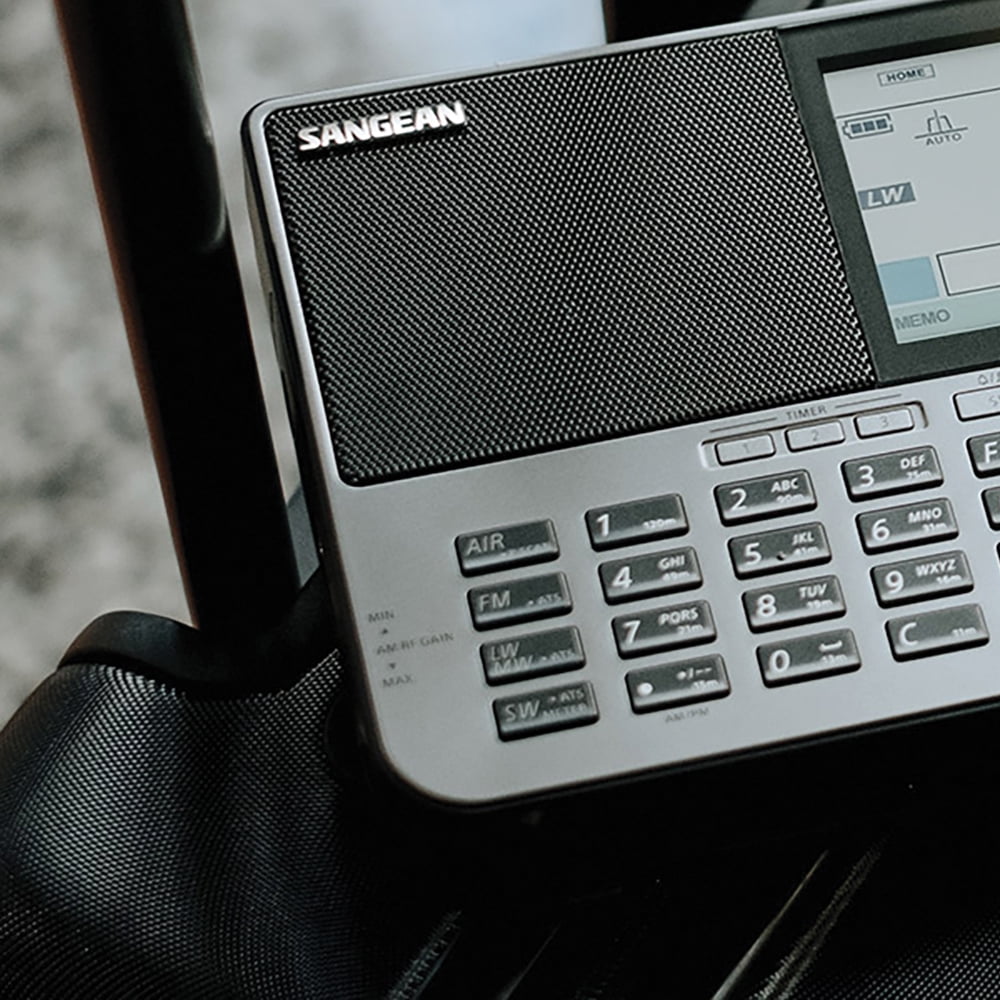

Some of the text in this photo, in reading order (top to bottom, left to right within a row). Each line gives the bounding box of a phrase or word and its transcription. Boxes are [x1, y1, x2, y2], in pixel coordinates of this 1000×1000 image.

[886, 67, 926, 83] HOME
[298, 100, 467, 150] SANGEAN
[925, 132, 962, 146] AUTO
[867, 185, 906, 208] LW
[894, 308, 951, 331] MEMO
[786, 405, 828, 421] TIMER
[881, 416, 890, 428] 3
[812, 431, 820, 442] 2
[984, 441, 998, 464] F
[857, 455, 926, 488] 3 DEF
[730, 478, 800, 511] 2 ABC
[596, 513, 610, 537] 1
[871, 507, 942, 541] 6 MNO
[467, 532, 506, 556] AIR
[744, 531, 815, 565] 5 JKL
[613, 555, 685, 589] 4 GHI
[885, 558, 956, 593] 9 WXYZ
[478, 590, 511, 612] FM
[757, 583, 827, 617] 8 TUV
[368, 610, 395, 623] MIN
[623, 607, 698, 644] 7 PQRS
[420, 632, 455, 647] GAIN
[900, 622, 918, 646] C
[490, 642, 519, 661] LW
[769, 649, 790, 672] 0
[495, 655, 533, 674] MW
[382, 674, 413, 688] MAX
[505, 688, 584, 722] SW ATS
